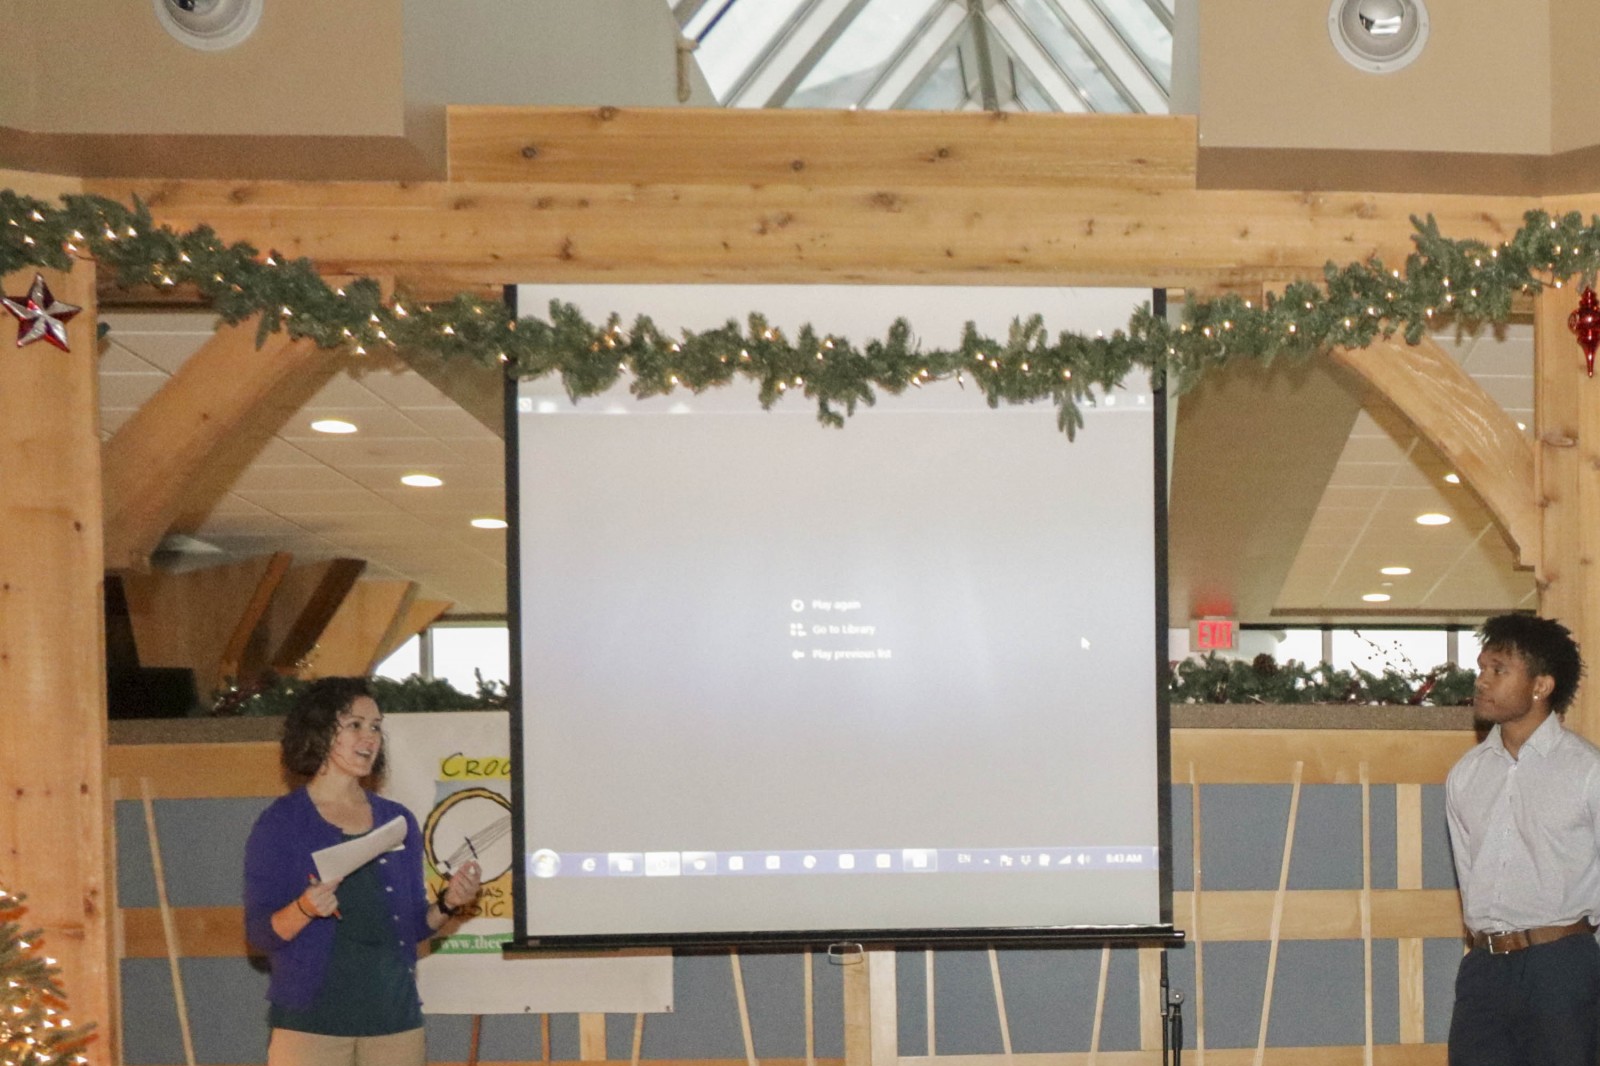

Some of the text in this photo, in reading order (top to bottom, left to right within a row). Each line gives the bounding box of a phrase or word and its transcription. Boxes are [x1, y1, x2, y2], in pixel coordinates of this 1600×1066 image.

[812, 624, 875, 636] Go to Library
[1198, 621, 1232, 648] EXIT
[812, 649, 891, 661] Play previous list
[442, 752, 511, 777] CROO
